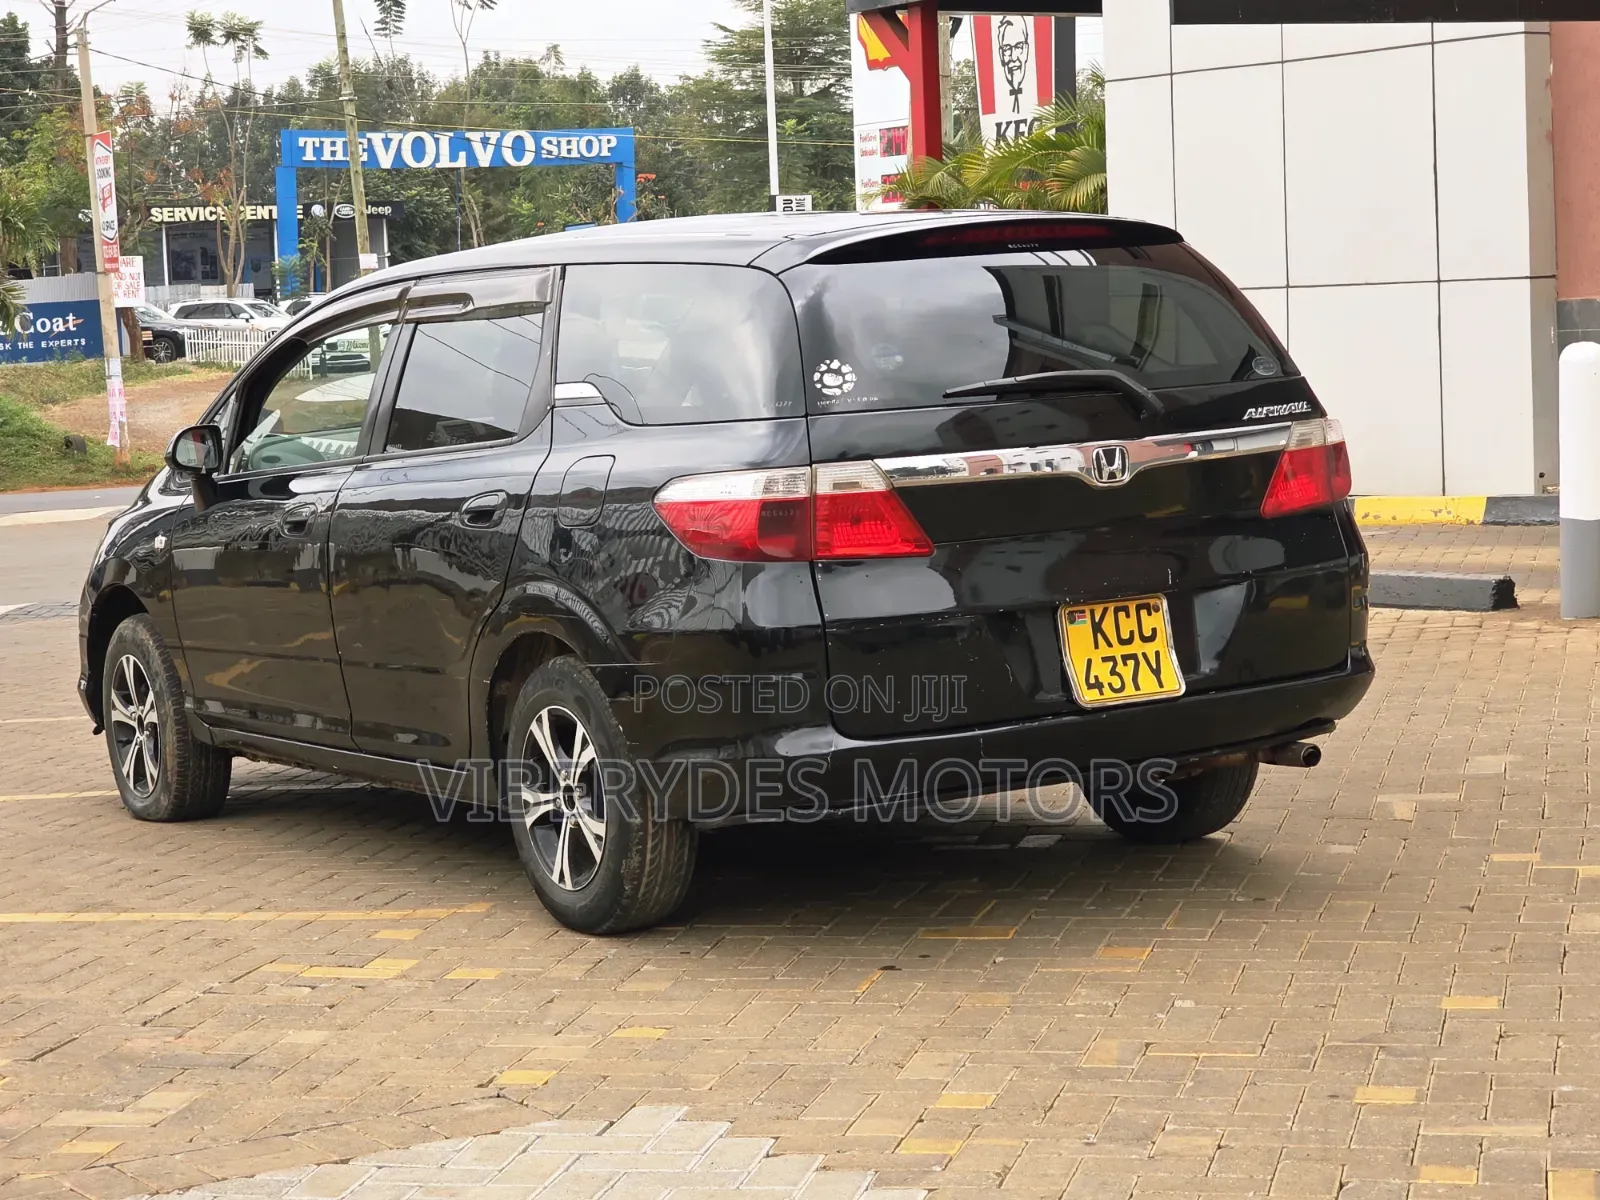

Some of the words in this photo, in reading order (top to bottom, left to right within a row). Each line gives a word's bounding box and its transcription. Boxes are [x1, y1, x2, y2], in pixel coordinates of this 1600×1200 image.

[365, 130, 536, 169] VOLVO
[540, 135, 617, 159] SHOP
[150, 205, 228, 222] SERVICE
[239, 205, 304, 220] ENTE
[366, 204, 392, 216] Jeep
[0, 343, 12, 351] SK
[18, 341, 34, 350] THE
[41, 338, 86, 348] EXPERTS
[1090, 602, 1158, 650] KCC
[1084, 650, 1165, 696] 437Y
